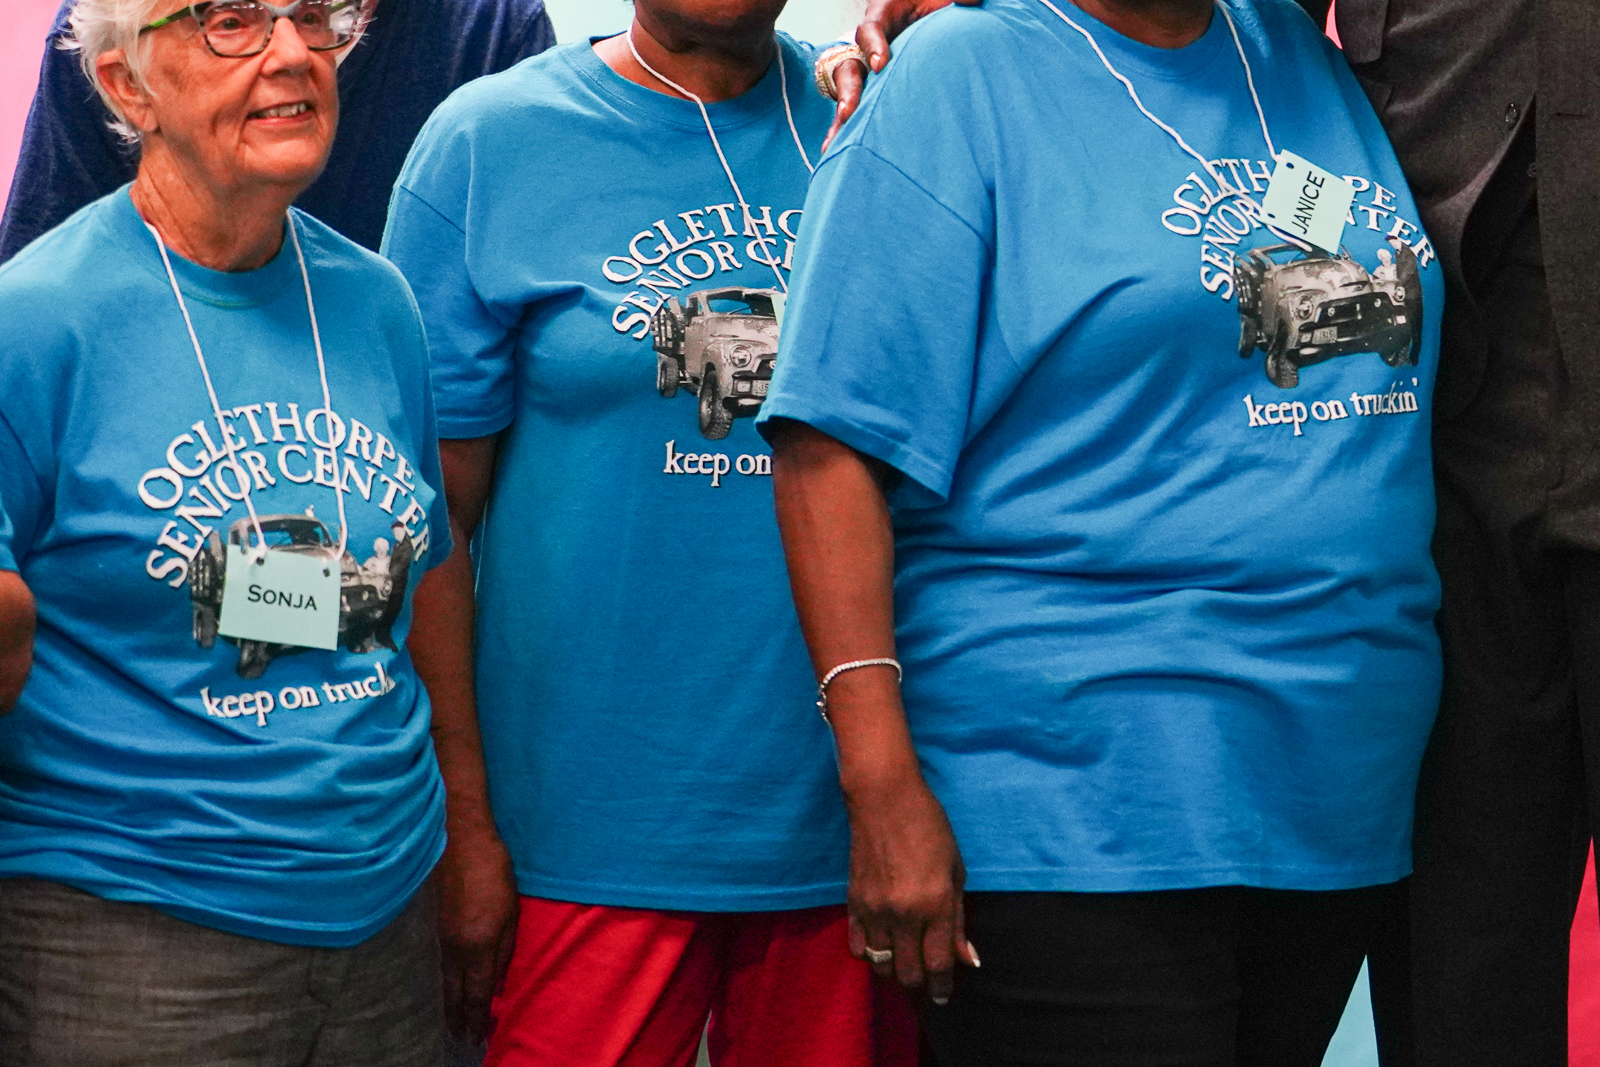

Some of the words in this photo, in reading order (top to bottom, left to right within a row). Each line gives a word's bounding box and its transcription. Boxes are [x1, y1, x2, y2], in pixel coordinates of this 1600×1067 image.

[1291, 170, 1326, 235] JANICE
[611, 241, 743, 340] SENIOR
[1200, 199, 1264, 300] SENIOR
[138, 402, 416, 510] OGLETHORPE
[1243, 394, 1309, 436] keep
[1311, 399, 1349, 420] on
[663, 440, 731, 487] keep
[735, 454, 772, 475] on
[146, 451, 276, 588] SENIOR
[277, 445, 430, 562] CENTER
[201, 686, 274, 726] keep
[279, 683, 320, 707] on
